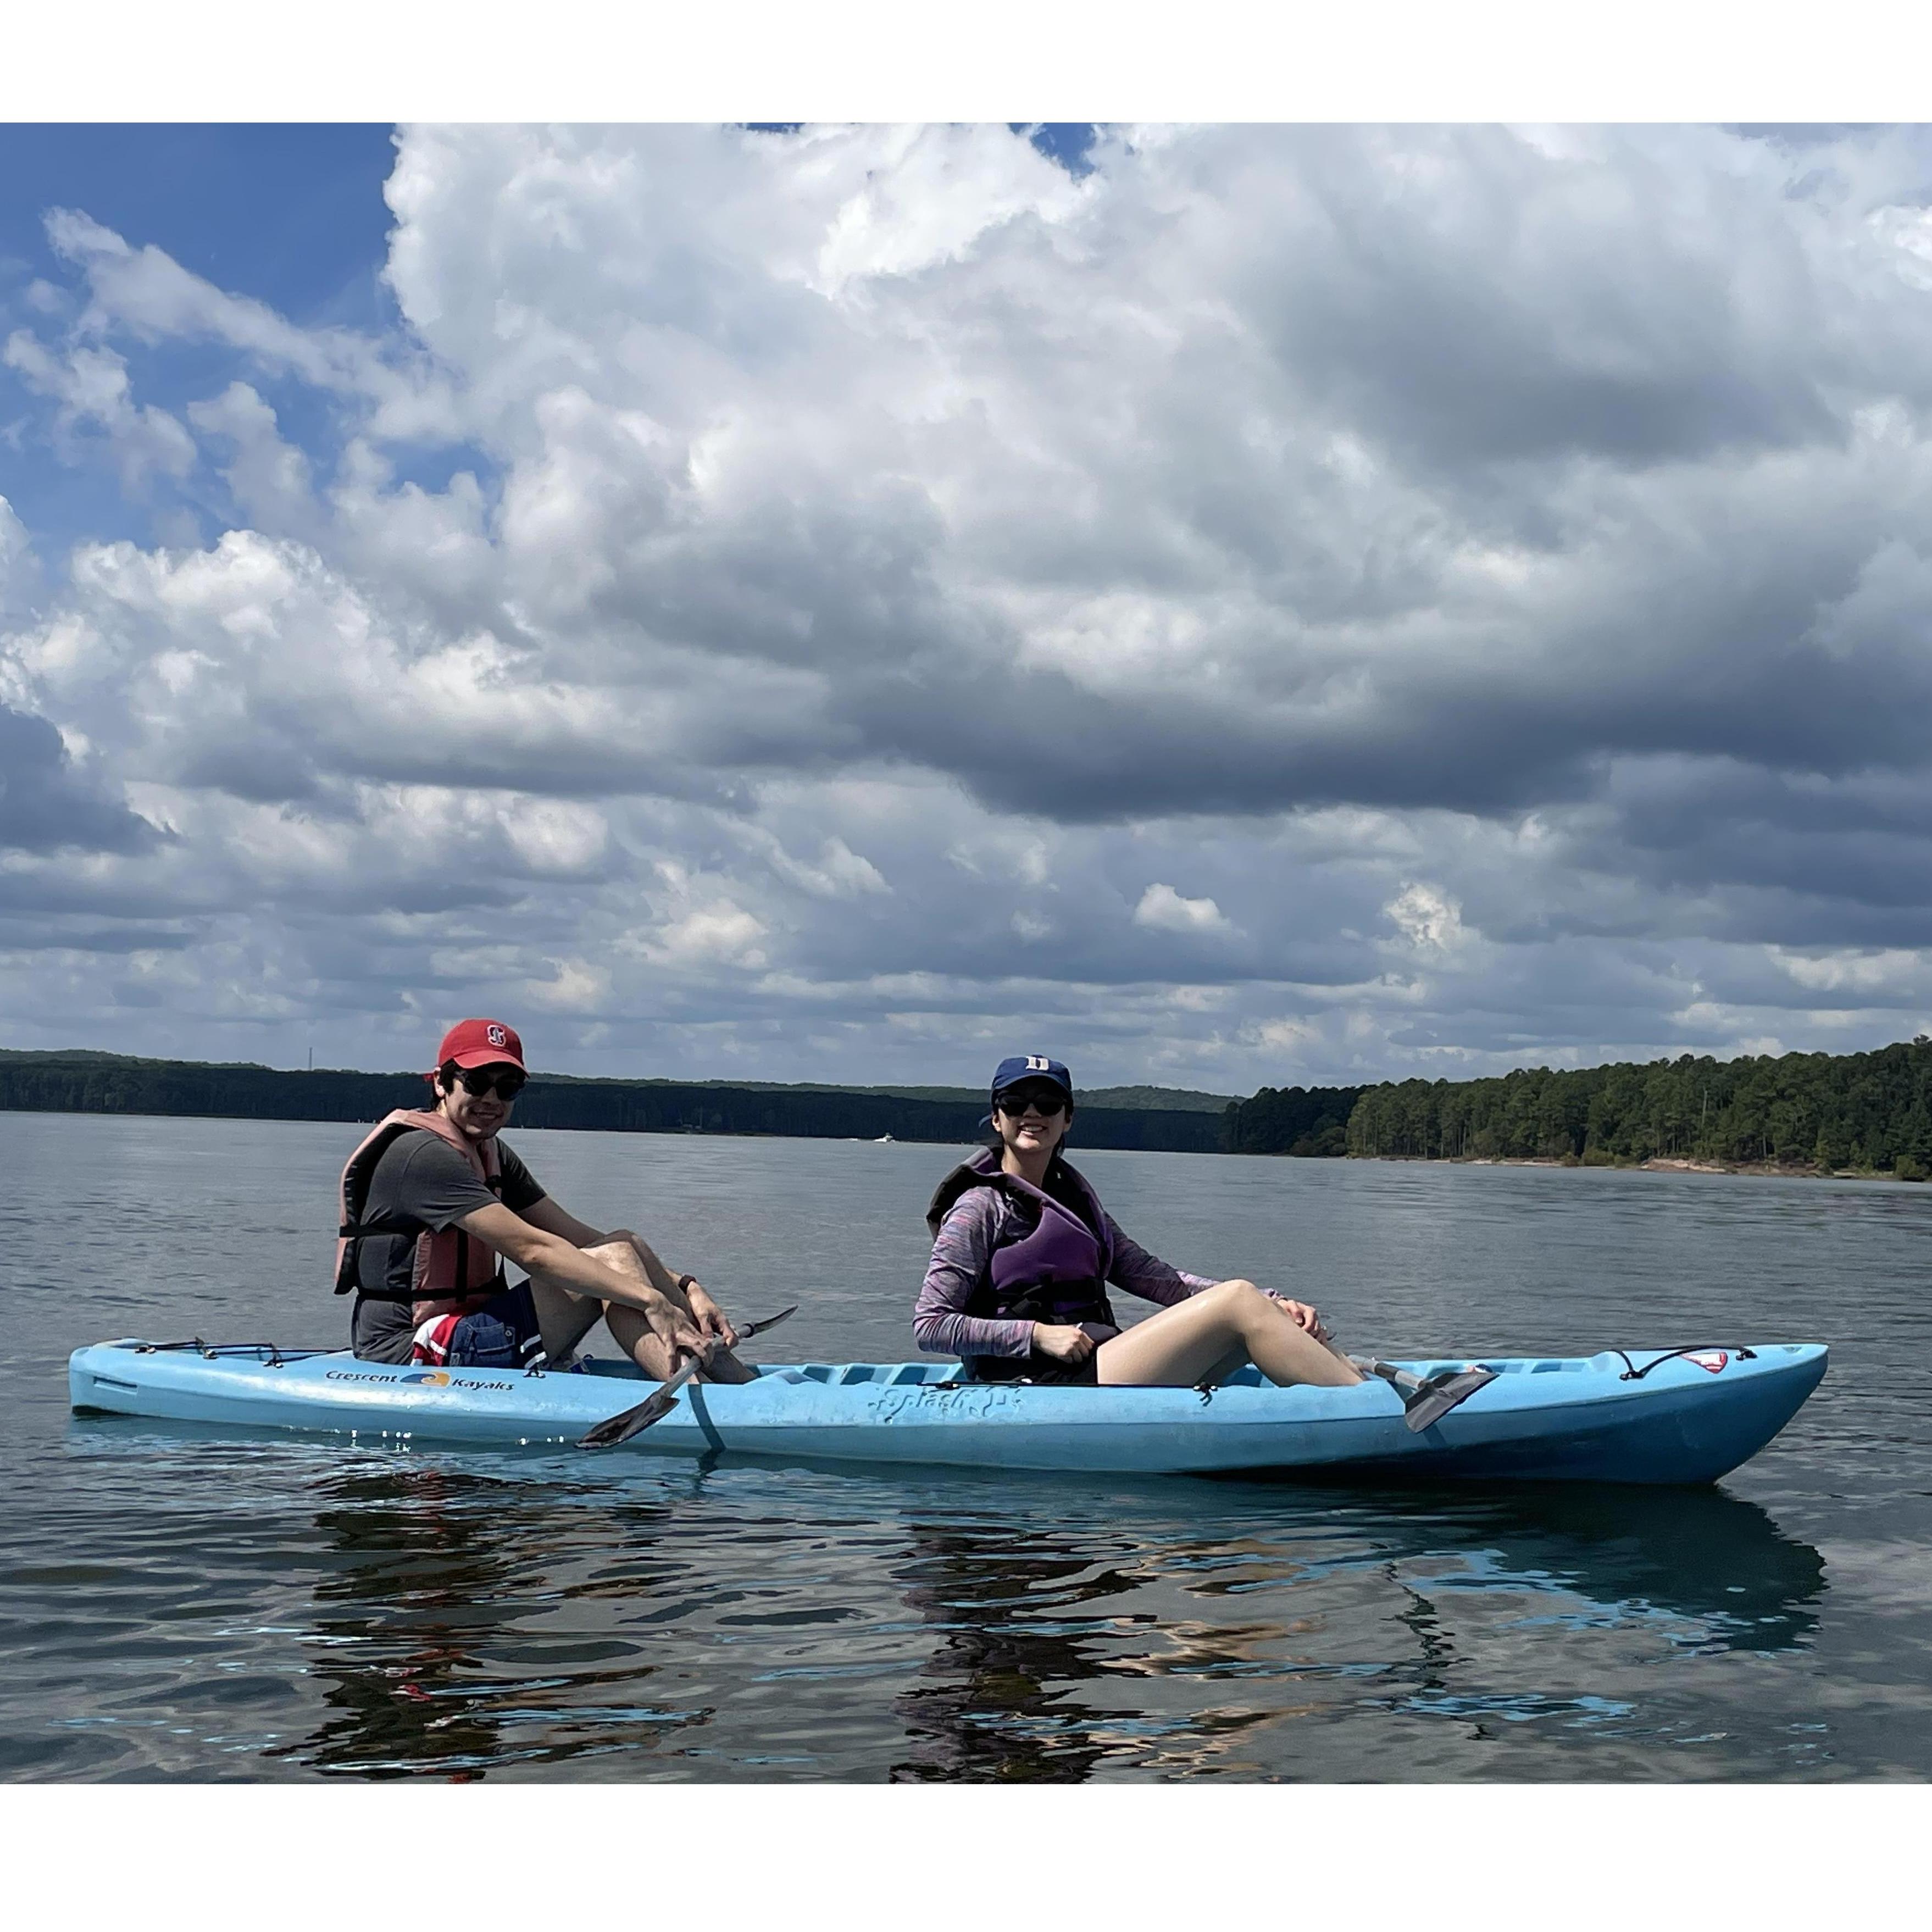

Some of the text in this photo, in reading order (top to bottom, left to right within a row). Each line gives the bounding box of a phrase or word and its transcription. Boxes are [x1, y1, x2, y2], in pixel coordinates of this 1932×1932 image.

[1026, 1057, 1049, 1070] D
[325, 1370, 514, 1391] Crescent Kayaks
